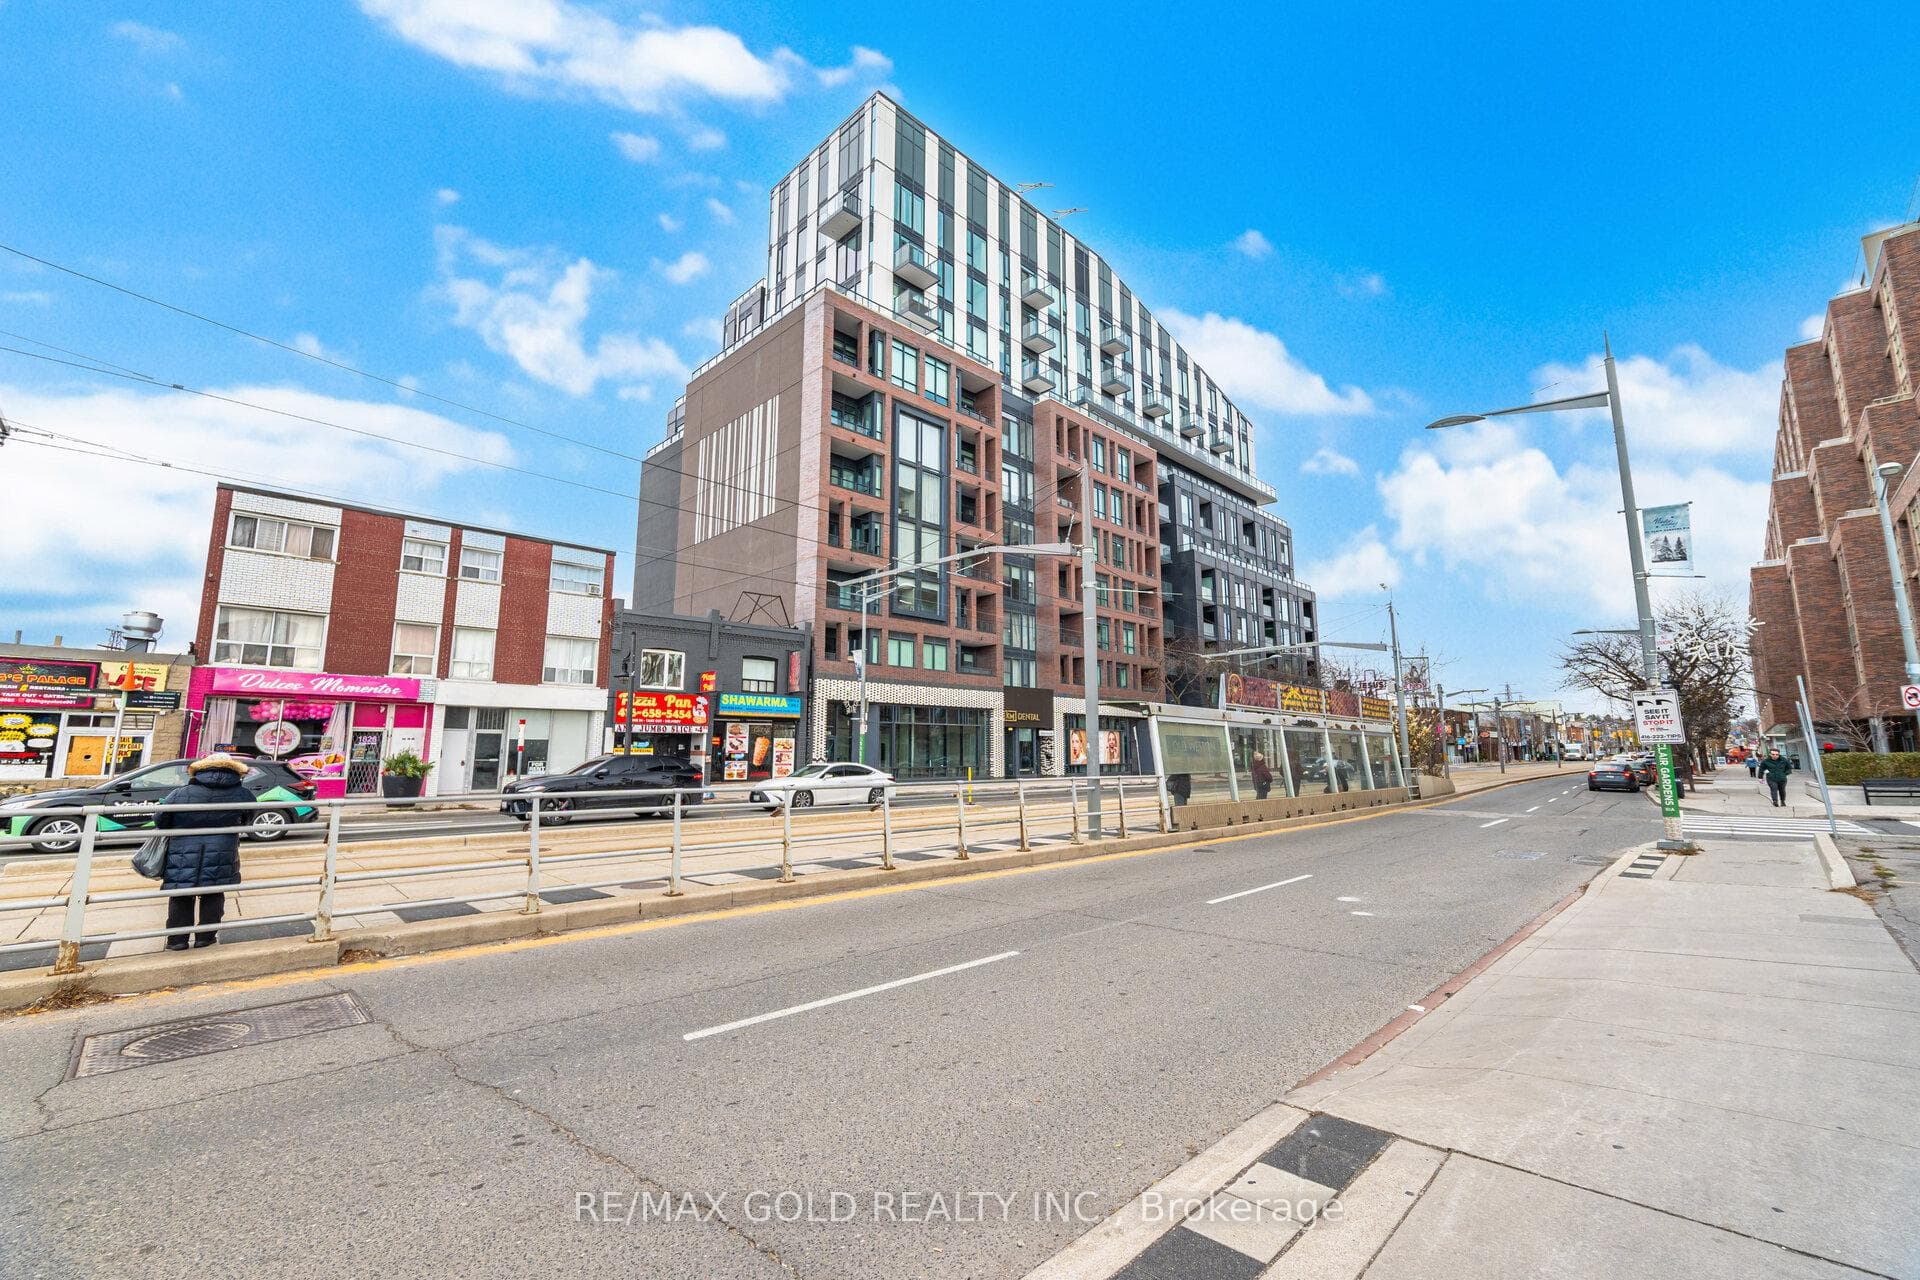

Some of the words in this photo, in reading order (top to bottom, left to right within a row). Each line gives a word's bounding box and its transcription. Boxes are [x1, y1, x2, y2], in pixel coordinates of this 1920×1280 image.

[27, 674, 86, 685] PALACE
[238, 673, 304, 691] Dulces
[310, 677, 402, 695] Momentos
[664, 694, 692, 708] Pan
[722, 694, 788, 708] SHAWARMA
[1018, 712, 1040, 721] DENTAL
[1660, 767, 1674, 806] GARDENS
